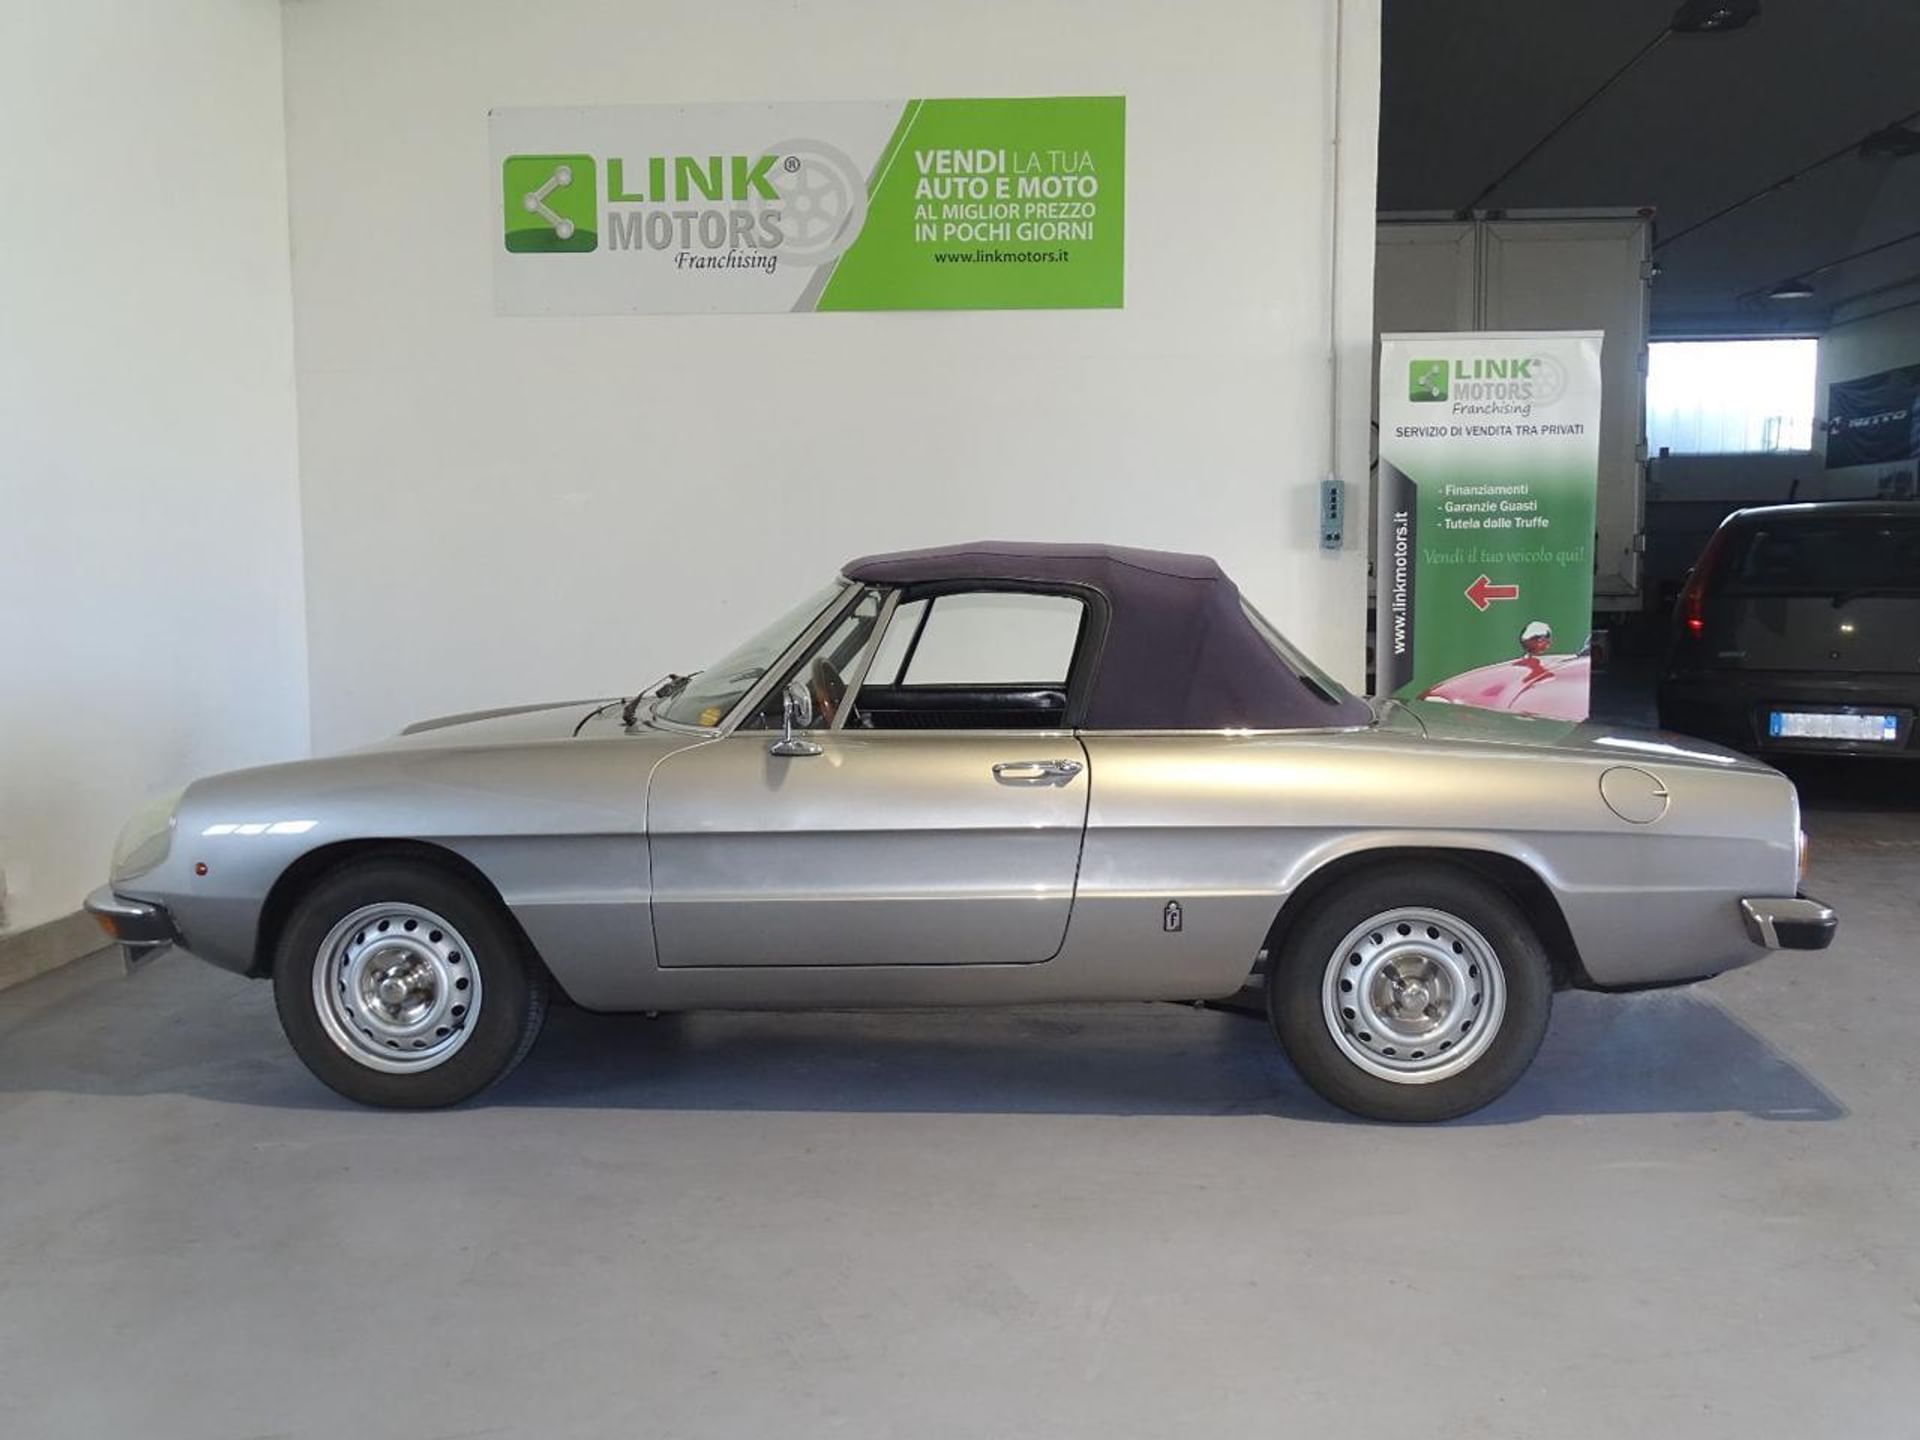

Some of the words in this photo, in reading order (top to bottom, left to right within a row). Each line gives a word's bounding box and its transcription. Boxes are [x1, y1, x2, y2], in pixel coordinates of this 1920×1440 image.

[915, 149, 1006, 174] VENDI
[1013, 151, 1042, 174] LA
[1048, 150, 1095, 173] TUA
[606, 155, 781, 202] LINK
[915, 177, 989, 200] AUTO
[996, 177, 1010, 199] E
[1016, 175, 1098, 199] MOTO
[914, 203, 938, 220] AL
[942, 203, 1020, 220] MIGLIOR
[1025, 202, 1096, 219] PREZZO
[607, 210, 784, 250] MOTORS
[915, 223, 937, 242] IN
[944, 222, 1011, 241] POCHI
[1016, 221, 1093, 241] GIORNI
[674, 249, 778, 274] Franchising
[934, 249, 1069, 264] www.linkmotors.it
[1454, 359, 1532, 380] LINK
[1453, 382, 1533, 401] MOTORS
[1452, 402, 1531, 417] Franchising
[1395, 426, 1447, 438] SERVIZIO
[1450, 426, 1463, 437] DI
[1465, 425, 1512, 436] VENDITA
[1515, 424, 1538, 436] TRA
[1541, 424, 1584, 435] PRIVATI
[1444, 501, 1498, 513] Garanzie
[1500, 499, 1538, 512] Guasti
[1393, 511, 1409, 654] www.linkmotors.it
